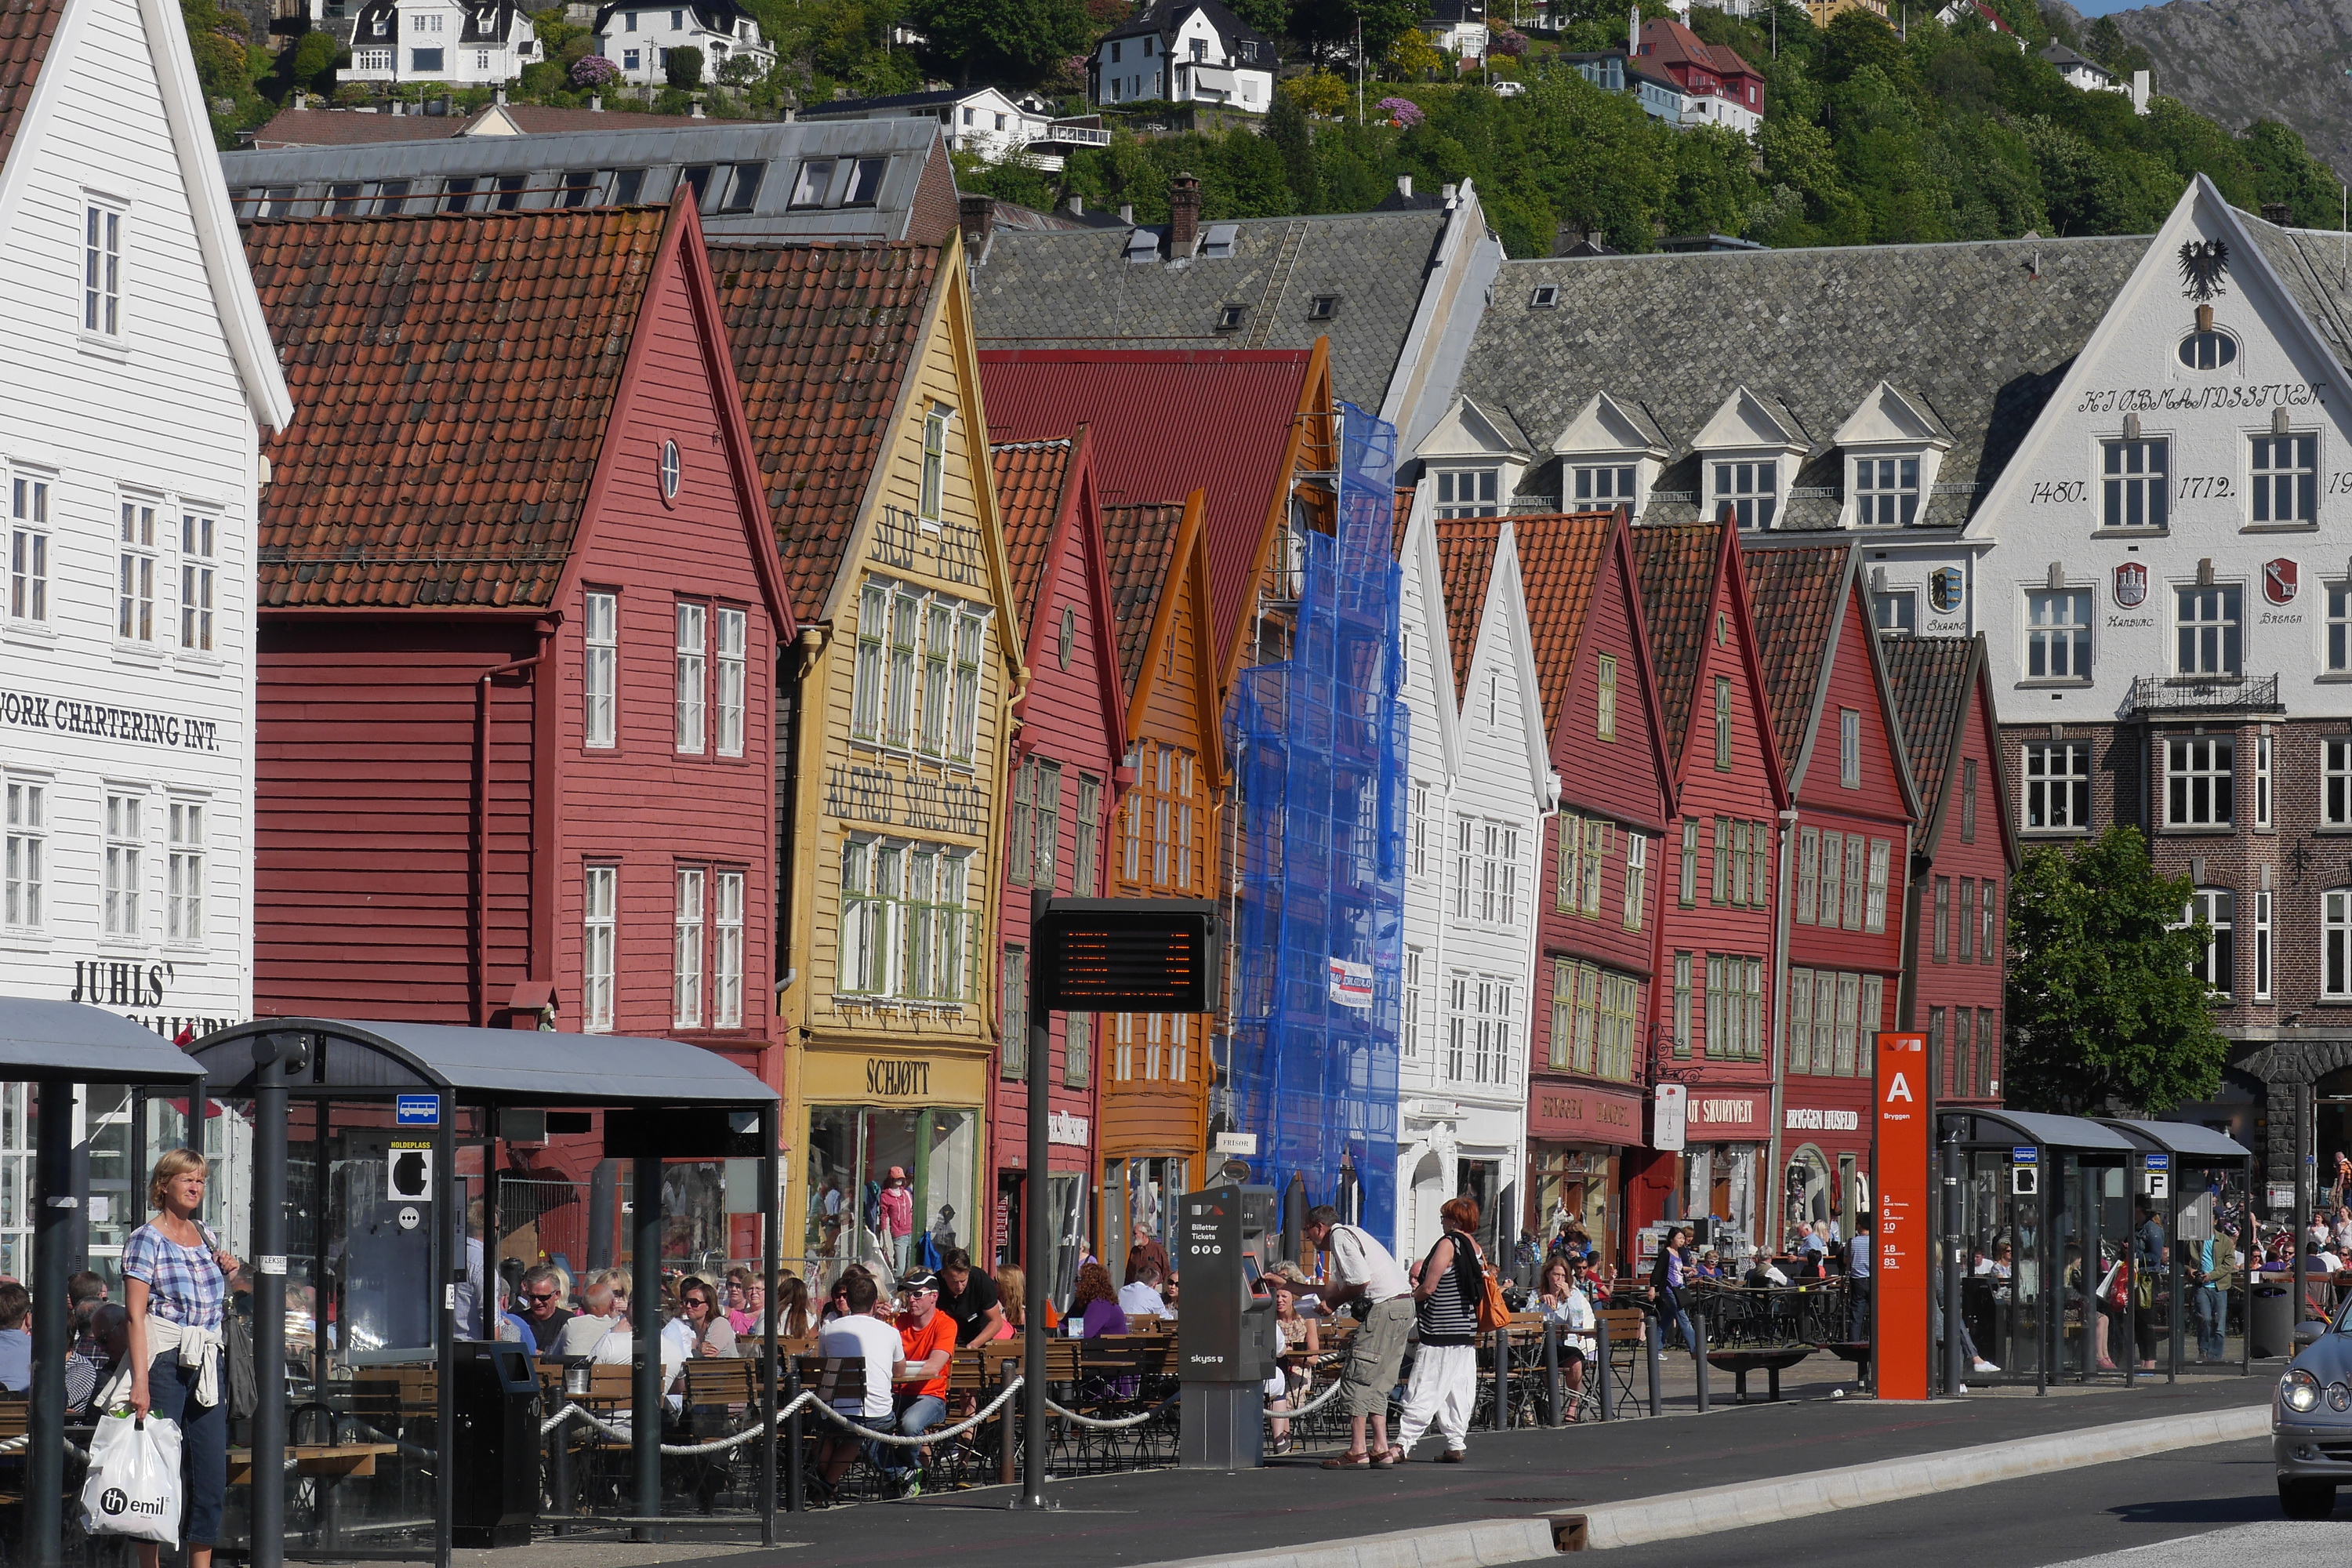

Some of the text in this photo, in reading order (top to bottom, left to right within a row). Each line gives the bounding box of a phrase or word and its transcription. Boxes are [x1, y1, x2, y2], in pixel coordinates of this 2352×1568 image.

[2030, 481, 2088, 504] 1480.
[2179, 476, 2235, 499] 1712.
[871, 503, 916, 570] SILD
[938, 521, 982, 586] FISK
[2259, 612, 2303, 624] BREMEN
[54, 700, 180, 746] CHARTERING
[184, 719, 220, 752] INT.
[826, 763, 981, 835] ALFRED SKULSTAD
[866, 1058, 930, 1095] SCHJØTT
[1886, 1072, 1913, 1102] A
[1541, 1096, 1583, 1120] BRYGGEN
[1686, 1099, 1700, 1123] UT
[1786, 1109, 1824, 1129] BRYGGEN
[2150, 1176, 2164, 1196] F
[1883, 1222, 1896, 1231] 10
[1191, 1355, 1217, 1364] skyss
[130, 1497, 165, 1515] emil
